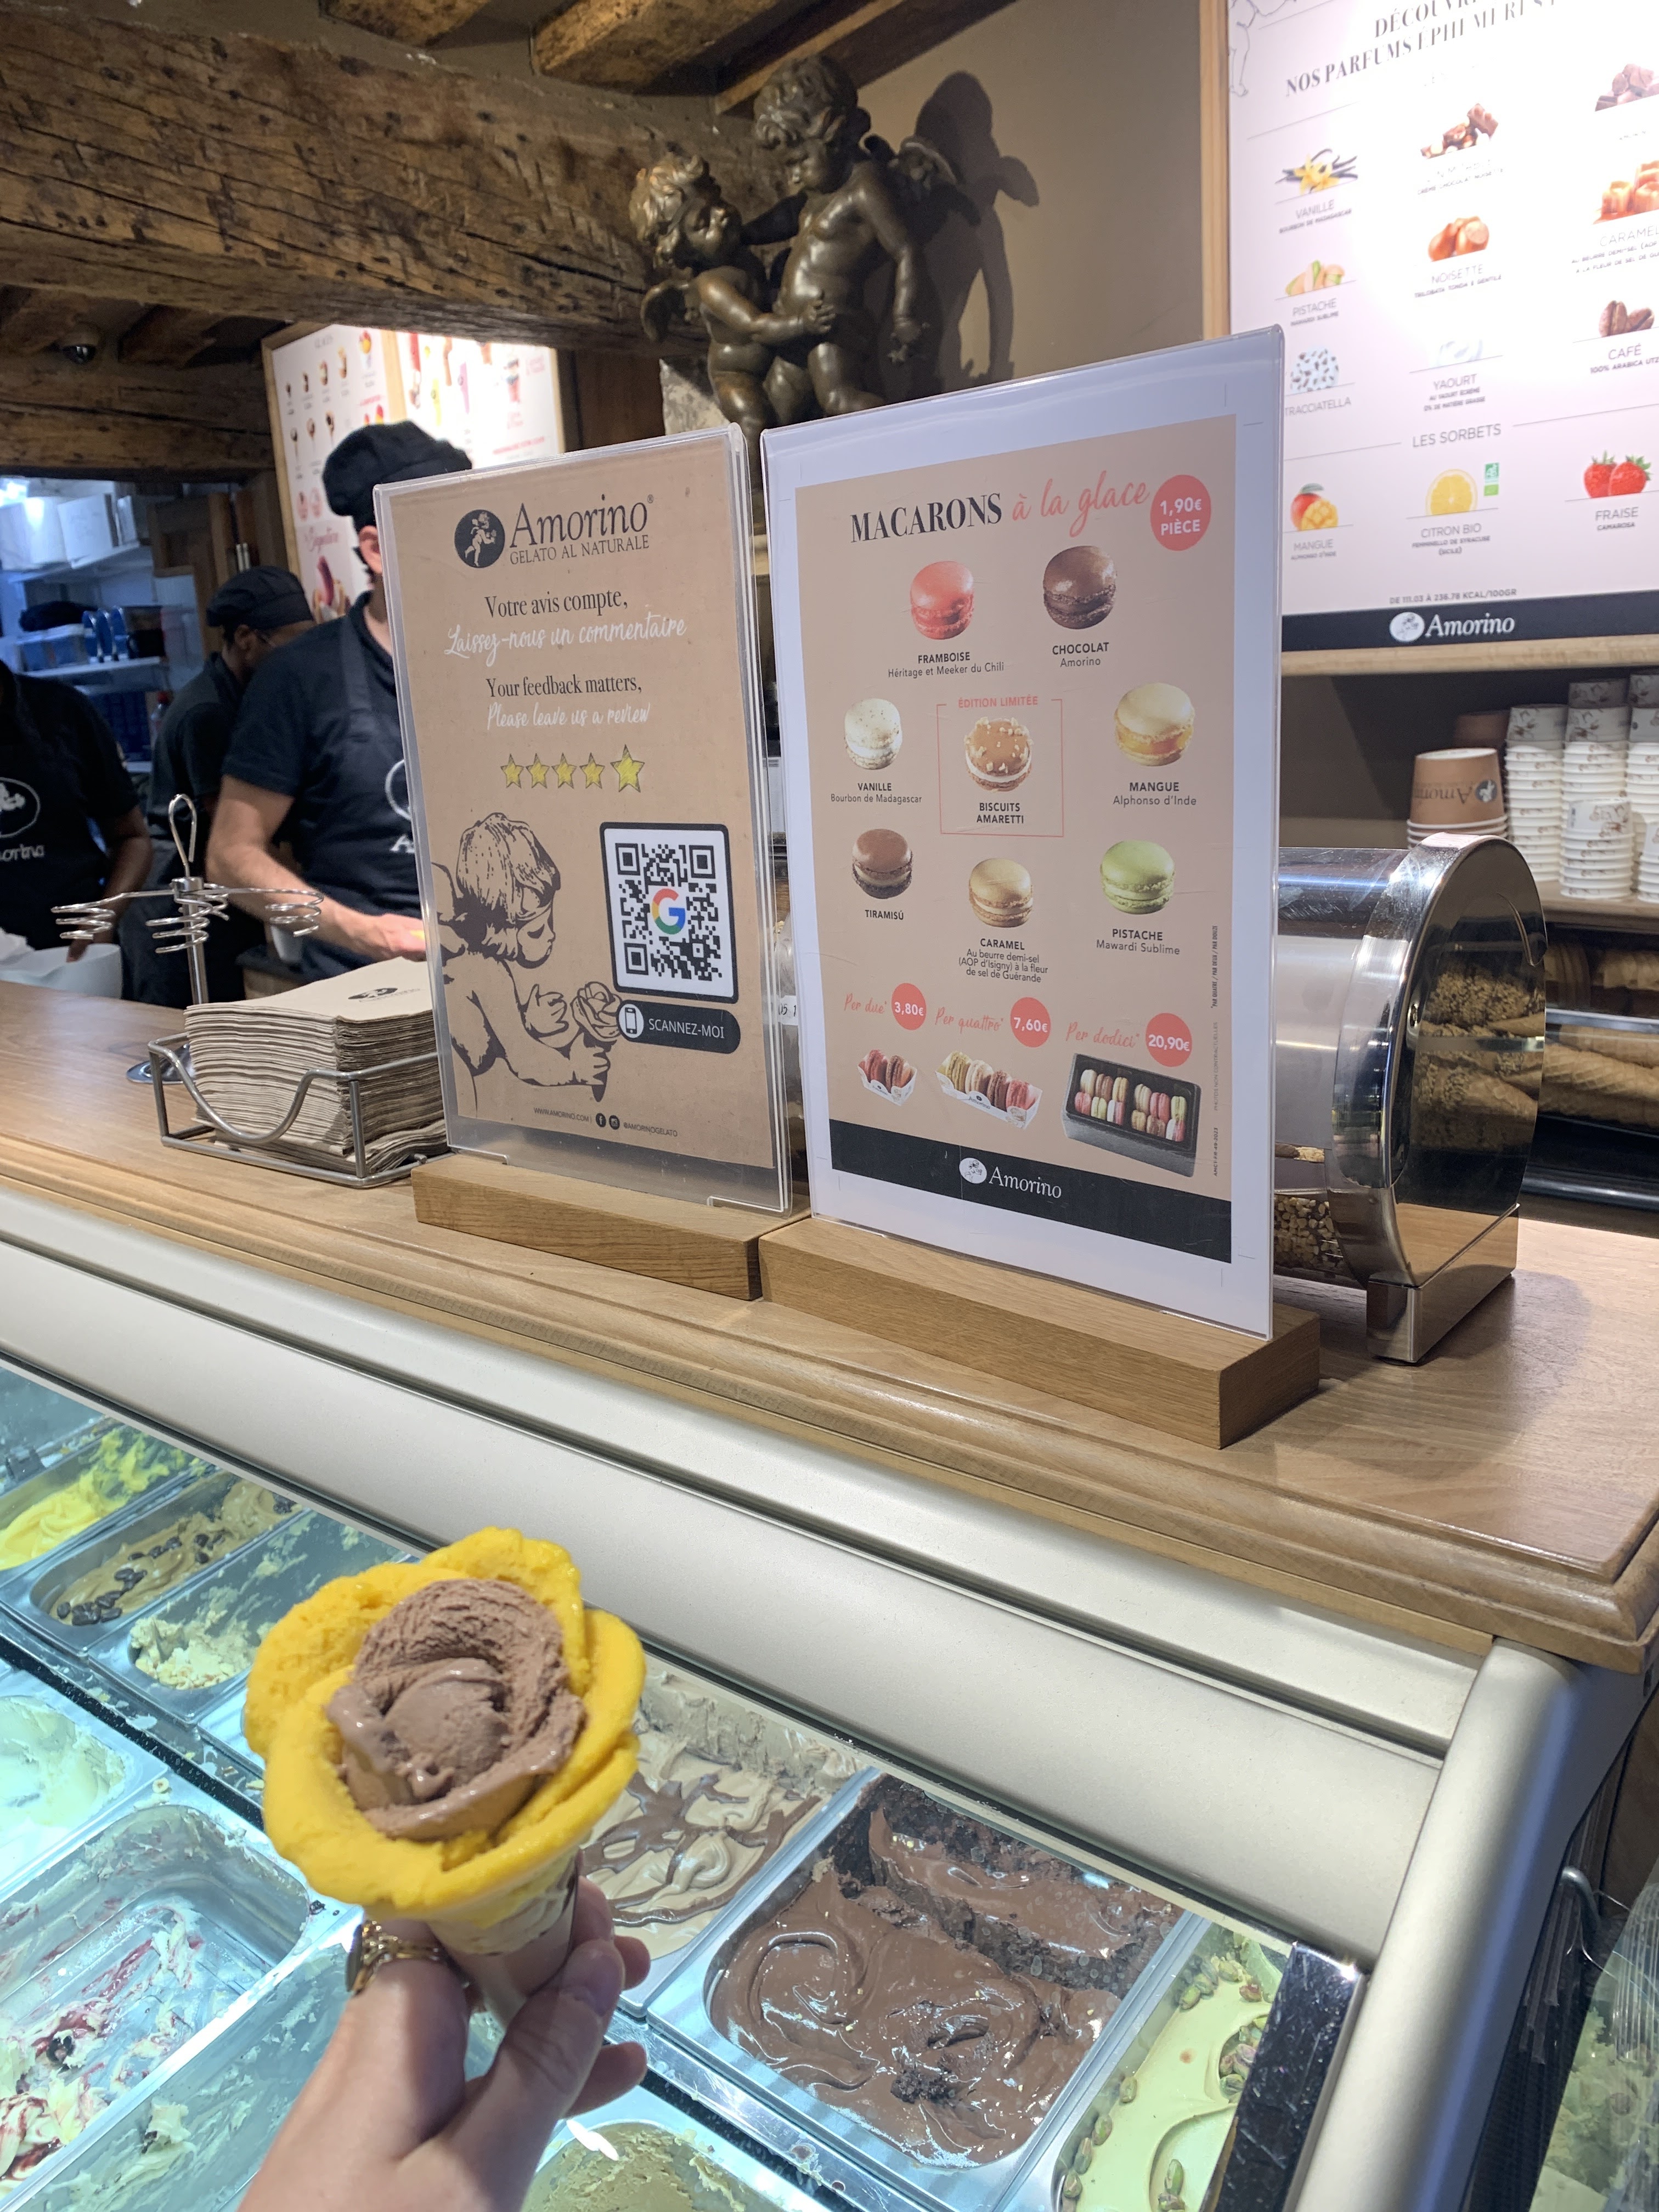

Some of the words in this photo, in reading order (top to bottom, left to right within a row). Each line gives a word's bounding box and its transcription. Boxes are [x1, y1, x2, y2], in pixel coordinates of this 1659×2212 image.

[1286, 69, 1320, 97] NOS
[1325, 36, 1412, 83] PARFUMS
[1296, 199, 1334, 218] VANILLE
[1600, 225, 1659, 246] CARAMEL
[1431, 264, 1483, 284] NOISETTE
[1293, 298, 1337, 316] PISTACHE
[1609, 343, 1641, 359] CAFÉ
[1612, 360, 1643, 370] ARABICA
[1434, 374, 1477, 390] YAOURT
[1285, 397, 1351, 415] TRACCIATELLA
[1412, 433, 1436, 447] LES
[1440, 424, 1502, 443] SORBETS
[850, 493, 1002, 543] MACARONS
[1012, 493, 1032, 521] à
[1041, 478, 1070, 517] la
[1070, 470, 1150, 538] glace
[1160, 496, 1203, 517] 1,90€
[1595, 506, 1639, 521] FRAISE
[1160, 519, 1200, 536] PIÈCE
[1421, 526, 1460, 538] CITRON
[1463, 523, 1482, 534] BIO
[510, 546, 556, 565] GELATO
[561, 544, 577, 558] AL
[581, 534, 650, 556] NATURALE
[1294, 539, 1334, 550] MANGUE
[484, 595, 527, 618] Votre
[532, 591, 560, 614] avis
[564, 589, 628, 616] compte,
[1425, 612, 1515, 638] Amorino
[444, 624, 546, 667] Laissez-nous
[551, 628, 574, 646] un
[579, 611, 687, 644] commentaire
[1052, 642, 1109, 655] CHOCOLAT
[918, 652, 970, 664] FRAMBOISE
[1060, 657, 1101, 668] Amorino
[888, 666, 923, 679] Héritage
[925, 667, 933, 675] et
[936, 665, 968, 675] Meeker
[971, 664, 981, 673] du
[985, 662, 1005, 672] Chili
[486, 678, 520, 697] Your
[523, 674, 583, 696] feedback
[585, 676, 642, 693] matters,
[958, 697, 997, 708] ÉDITION
[1000, 695, 1039, 707] LIMITÉE
[487, 702, 529, 730] Please
[533, 702, 567, 726] leave
[571, 709, 588, 726] us
[592, 711, 604, 724] a
[607, 702, 651, 725] review
[857, 782, 892, 791] VANILLE
[1130, 782, 1180, 791] MANGUE
[831, 793, 861, 802] Bourbon
[864, 794, 873, 802] de
[876, 794, 922, 805] Madagascar
[1113, 795, 1160, 808] Alphonso
[979, 803, 1020, 812] BISCUITS
[977, 815, 1024, 823] AMARETTI
[1112, 928, 1163, 941] PISTACHE
[980, 938, 1025, 950] CARAMEL
[1096, 939, 1137, 951] Mawardi
[1141, 943, 1180, 955] Sublime
[967, 949, 977, 957] Au
[979, 949, 1005, 960] beurre
[1007, 952, 1040, 963] demi-sel
[958, 957, 978, 966] (AOP
[1015, 962, 1019, 971] à
[1022, 963, 1028, 972] la
[1030, 963, 1048, 973] fleur
[966, 967, 975, 975] de
[978, 969, 988, 977] sel
[991, 969, 1000, 978] de
[1002, 970, 1041, 983] Guérande
[844, 993, 861, 1011] Per
[894, 1001, 924, 1016] 3,80€
[935, 1006, 954, 1025] Per
[648, 1018, 725, 1039] SCANNEZ-MOI
[1013, 1017, 1048, 1032] 7,60€
[1065, 1022, 1088, 1041] Per
[1148, 1034, 1190, 1052] 20,90€
[534, 1107, 589, 1122] WWW.AMORINO.COM
[623, 1122, 678, 1137] @AMORINOGELATO
[989, 1166, 1062, 1199] Amorino
